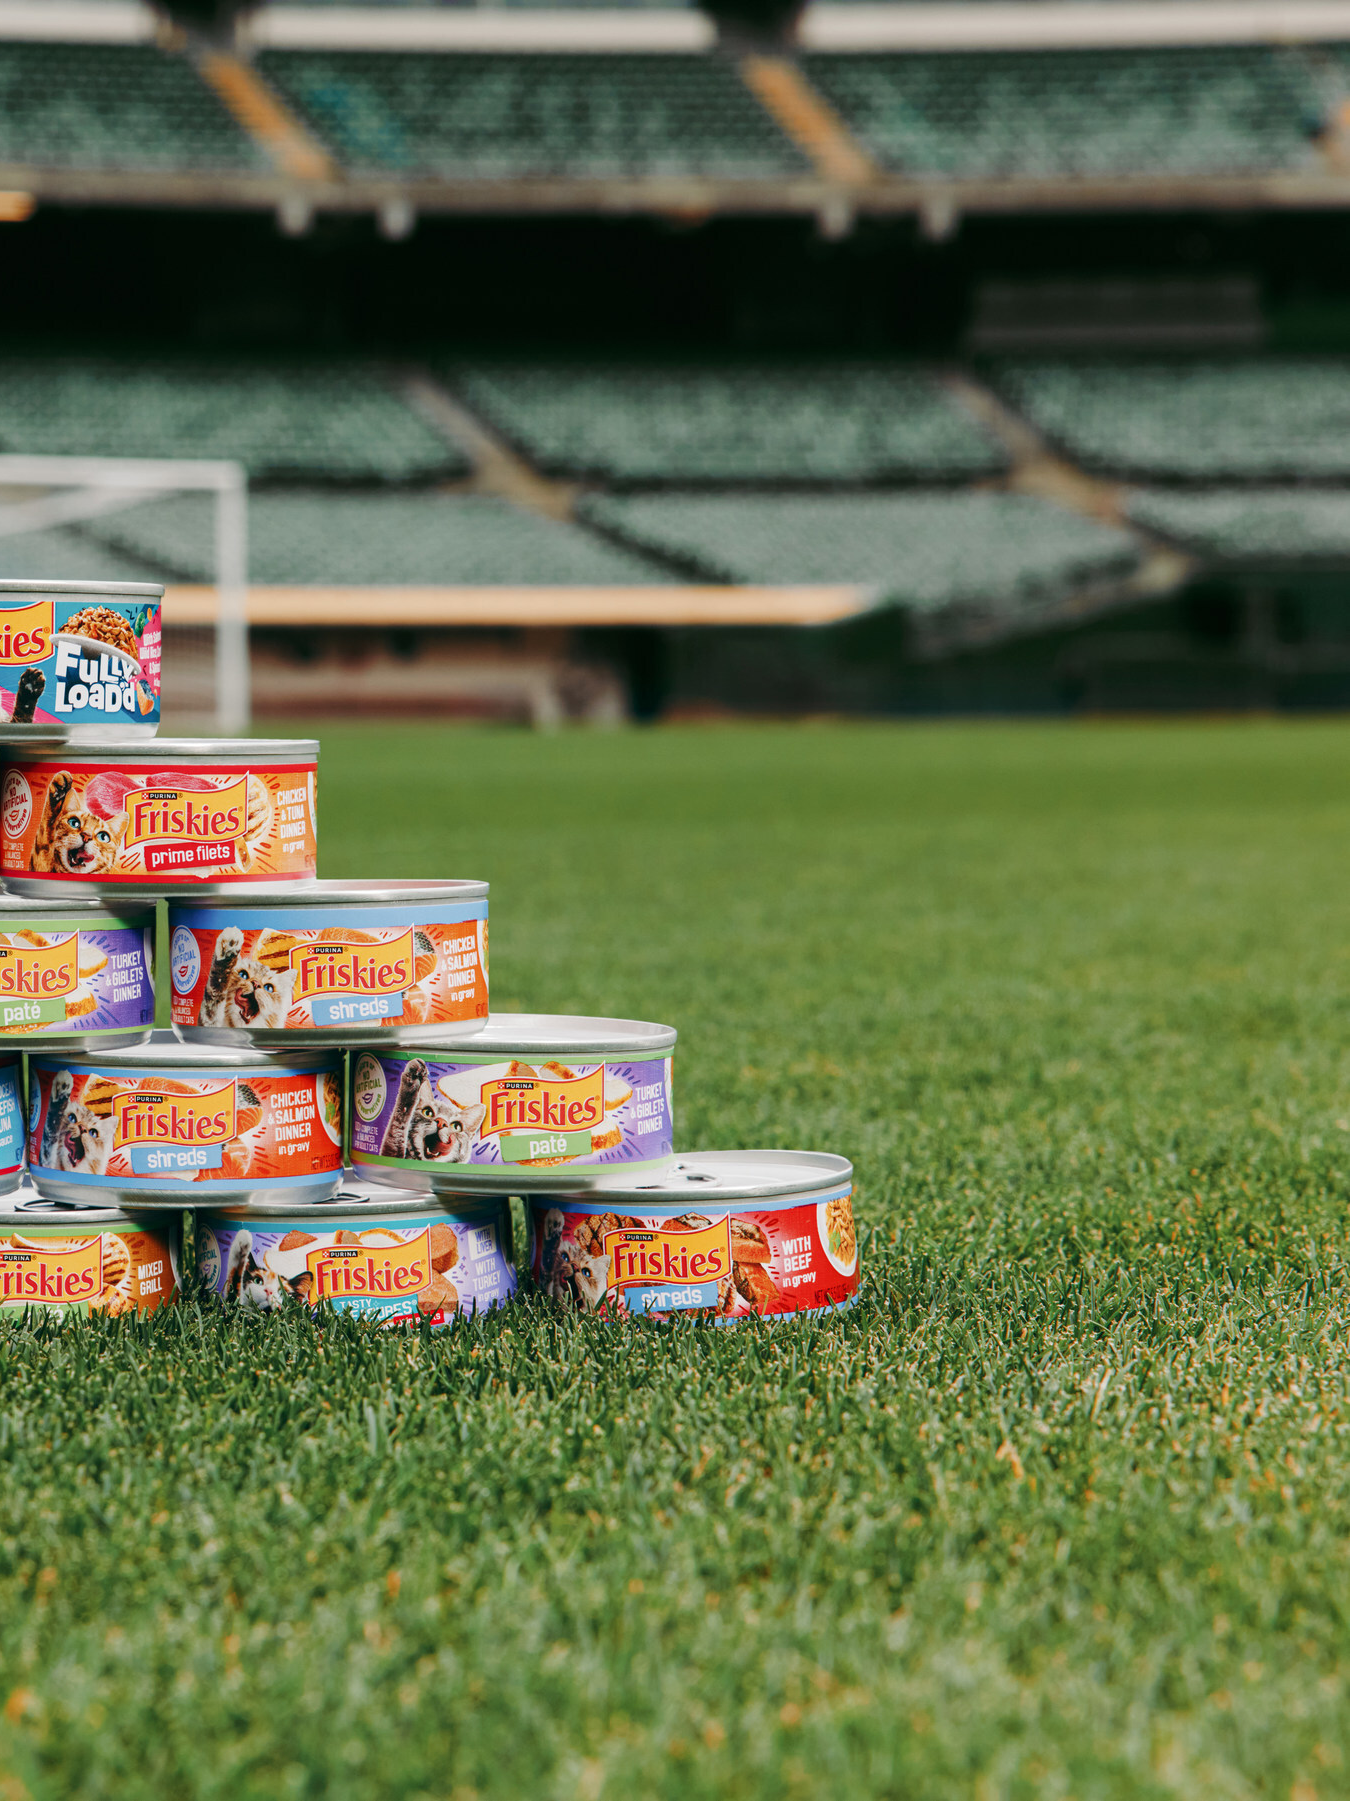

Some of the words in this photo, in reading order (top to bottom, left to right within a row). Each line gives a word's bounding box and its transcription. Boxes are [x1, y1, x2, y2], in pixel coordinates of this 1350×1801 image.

[150, 792, 177, 800] PURINA
[277, 786, 306, 806] CHICKEN
[134, 802, 239, 838] Friskies
[281, 809, 286, 822] &
[286, 804, 305, 821] TUNA
[280, 820, 306, 839] DINNER
[151, 849, 194, 868] prime
[196, 844, 230, 862] filets
[442, 934, 476, 955] CHICKEN
[110, 950, 141, 970] TURKEY
[447, 951, 478, 970] SALMON
[106, 975, 112, 986] &
[112, 966, 144, 986] GIBLETS
[300, 954, 405, 992] Friskies
[448, 968, 476, 988] DINNER
[114, 984, 142, 1002] DINNER
[4, 1002, 41, 1025] paté
[330, 998, 388, 1020] shreds
[270, 1088, 312, 1108] CHICKEN
[636, 1082, 662, 1102] TURKEY
[268, 1113, 275, 1125] &
[275, 1104, 315, 1124] SALMON
[490, 1090, 596, 1128] Friskies
[630, 1108, 636, 1119] &
[636, 1098, 664, 1118] GIBLETS
[122, 1104, 228, 1142] Friskies
[275, 1122, 312, 1142] DINNER
[638, 1116, 662, 1136] DINNER
[278, 1146, 286, 1155] in
[288, 1142, 310, 1156] gravy
[530, 1134, 567, 1158] paté
[147, 1148, 207, 1170] shreds
[782, 1236, 812, 1256] WITH
[3, 1254, 30, 1262] PURINA
[476, 1258, 496, 1276] WITH
[613, 1242, 722, 1280] Friskies
[784, 1252, 812, 1272] BEEF
[138, 1260, 163, 1280] MIXED
[316, 1258, 424, 1296] Friskies
[782, 1278, 792, 1288] in
[792, 1272, 816, 1288] gravy
[140, 1277, 162, 1296] GRILL
[473, 1270, 500, 1292] TURKEY
[642, 1286, 702, 1308] shreds
